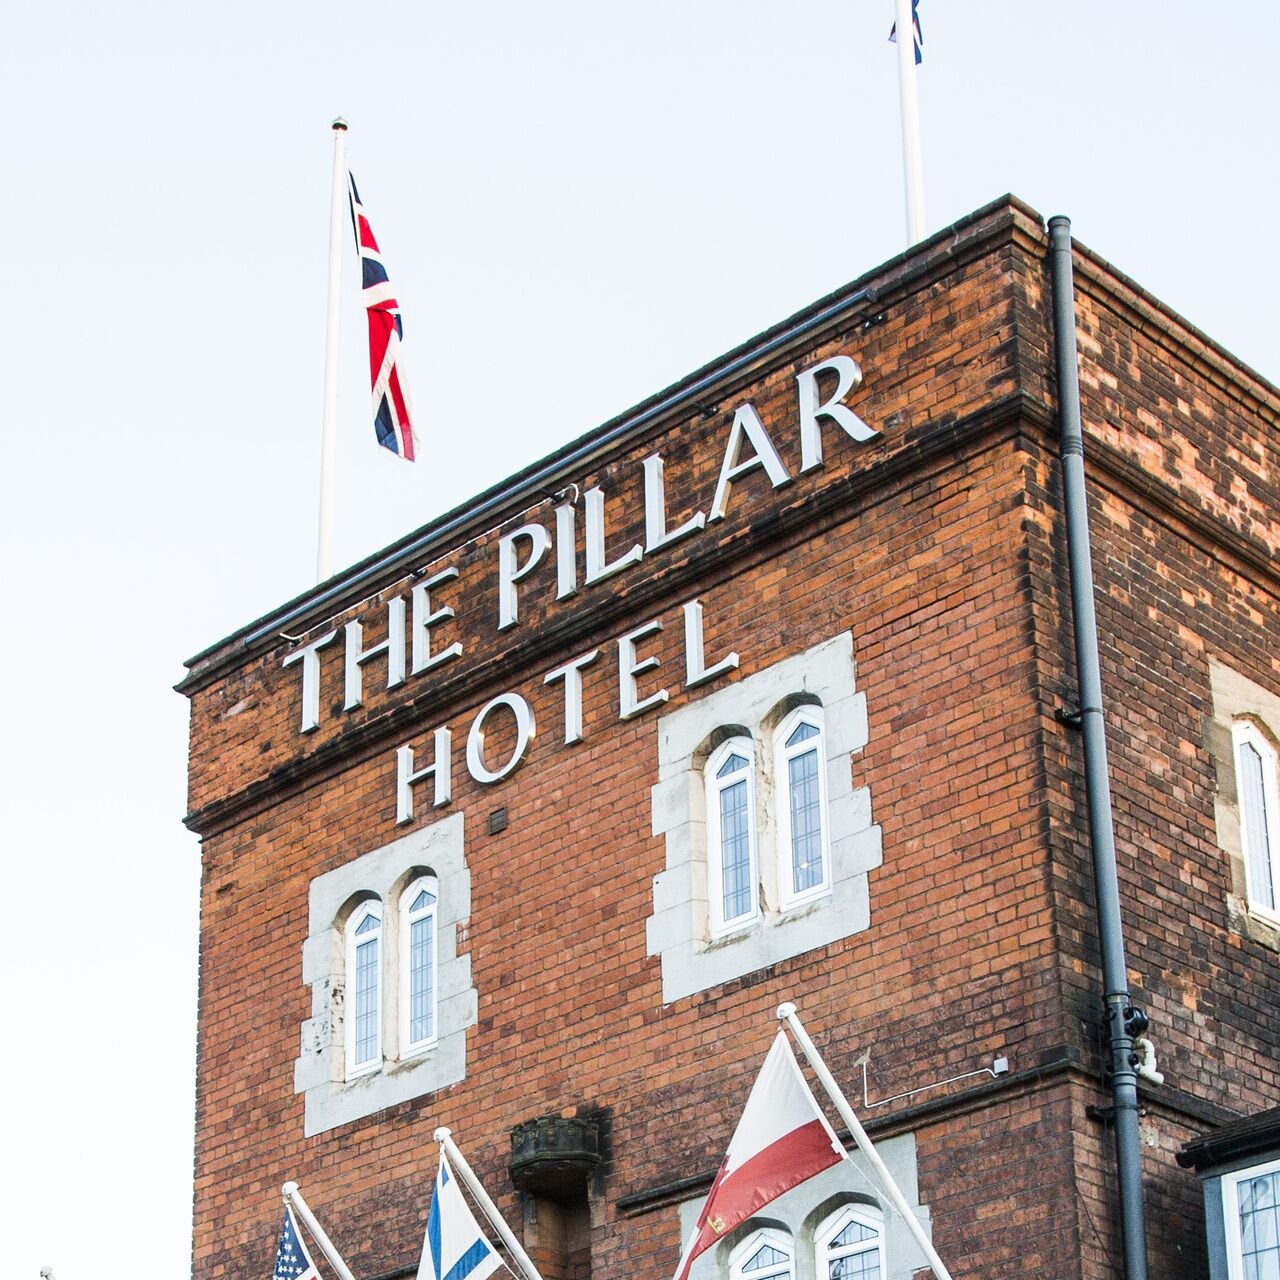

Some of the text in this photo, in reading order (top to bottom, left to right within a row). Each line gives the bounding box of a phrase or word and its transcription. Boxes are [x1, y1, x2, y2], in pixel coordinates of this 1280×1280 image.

[283, 355, 882, 733] THE PILLAR
[396, 599, 740, 826] HOTEL
